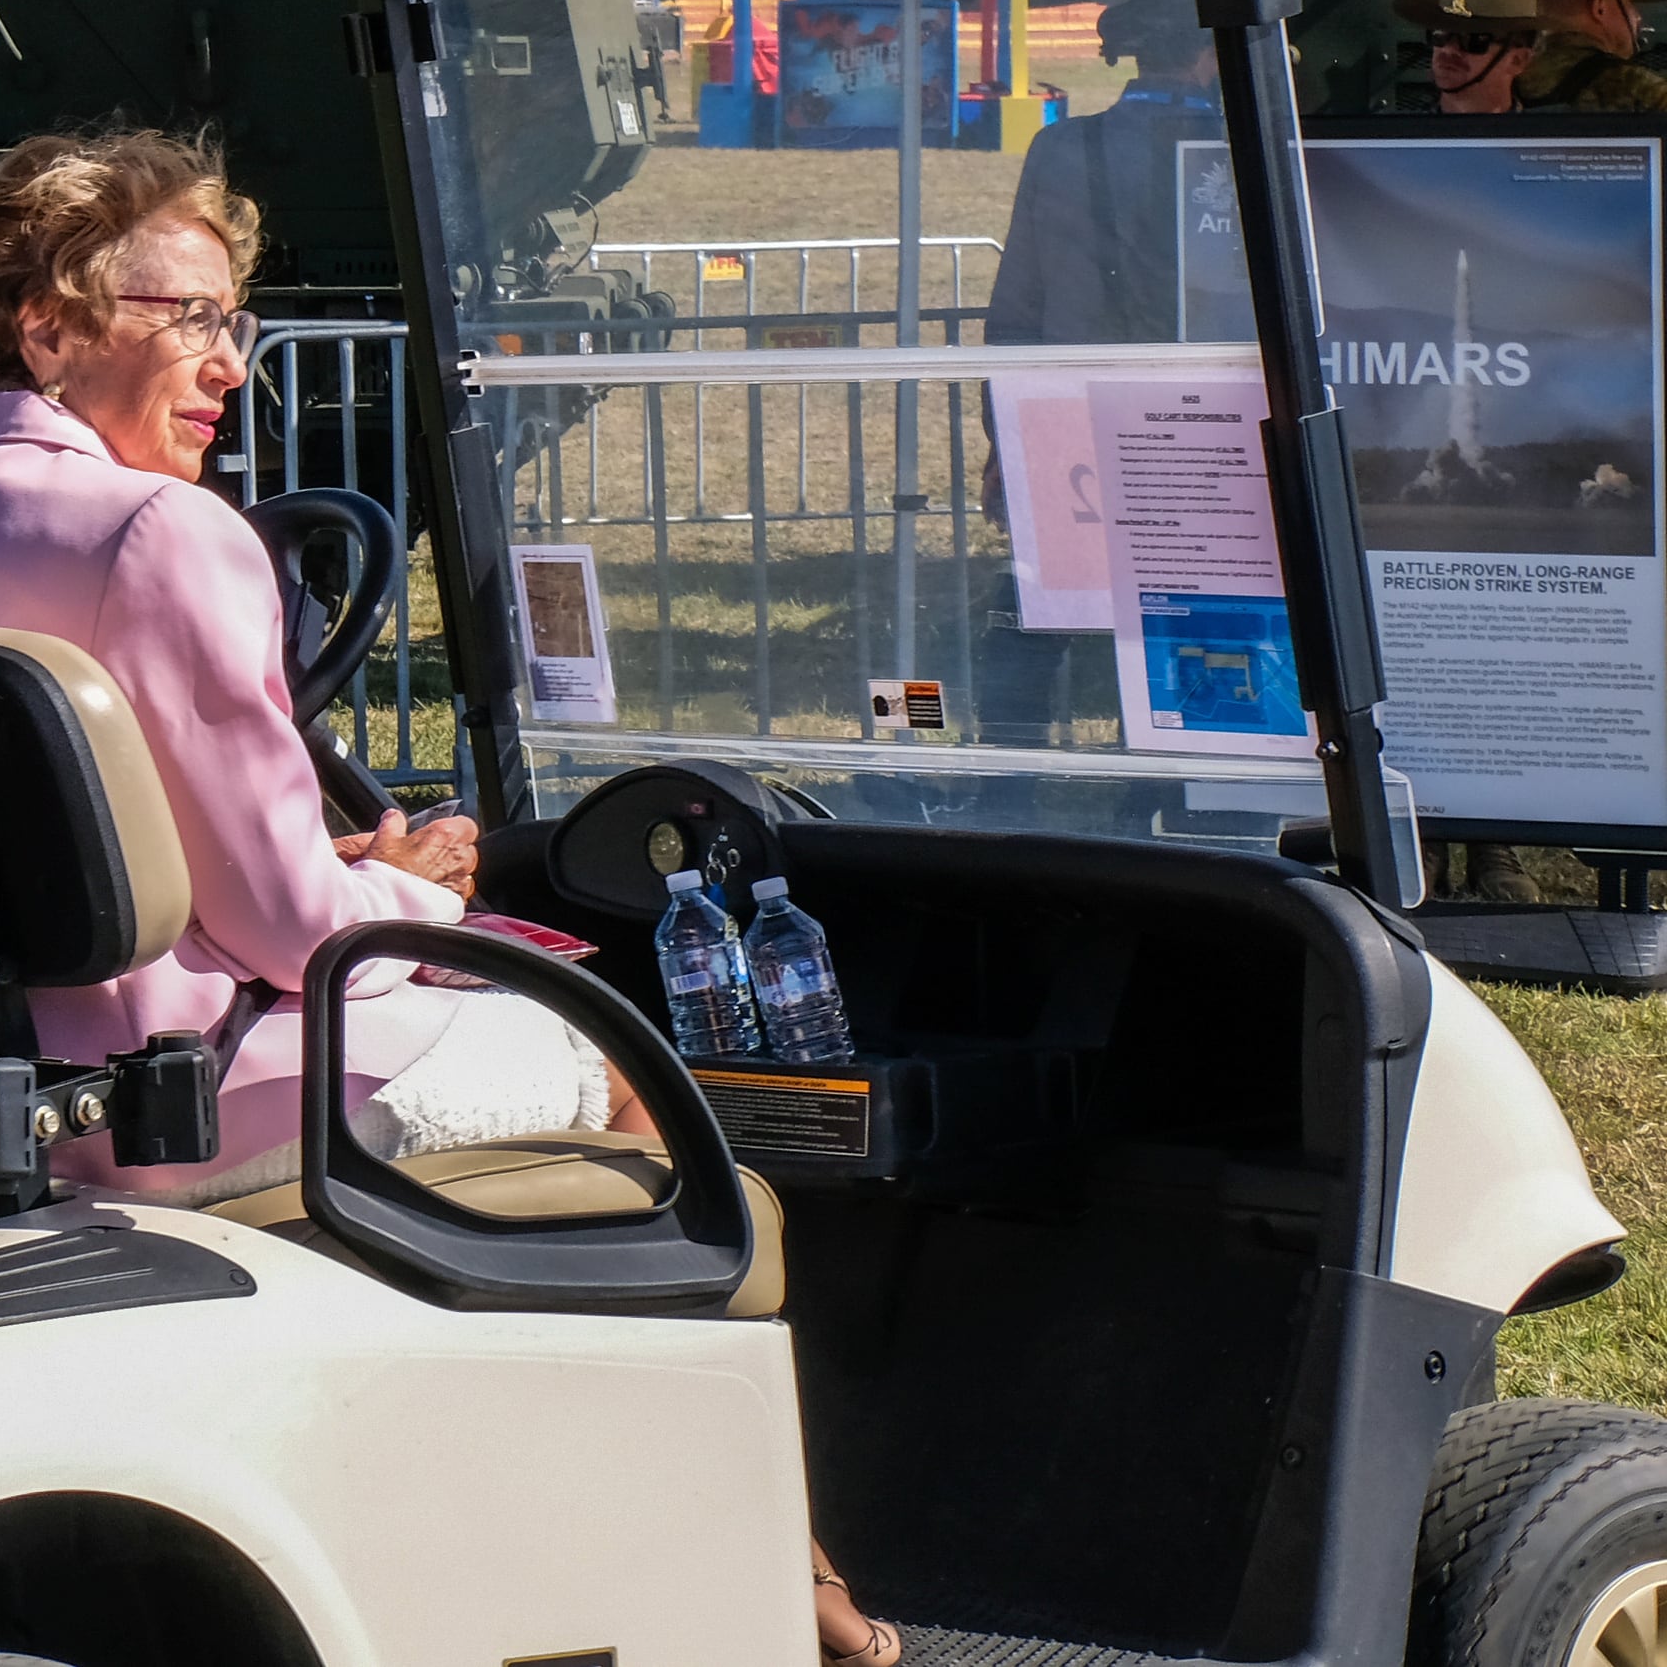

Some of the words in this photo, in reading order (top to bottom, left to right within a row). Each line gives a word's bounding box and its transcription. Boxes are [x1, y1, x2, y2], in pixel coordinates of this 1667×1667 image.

[1320, 341, 1531, 386] HIMARS
[1383, 562, 1521, 578] BATTLE-PROVEN,
[1526, 565, 1635, 580] LONG-RANGE
[1383, 578, 1469, 591] PRECISION
[1475, 579, 1532, 593] STRIKE
[1538, 580, 1608, 594] SYSTEM.
